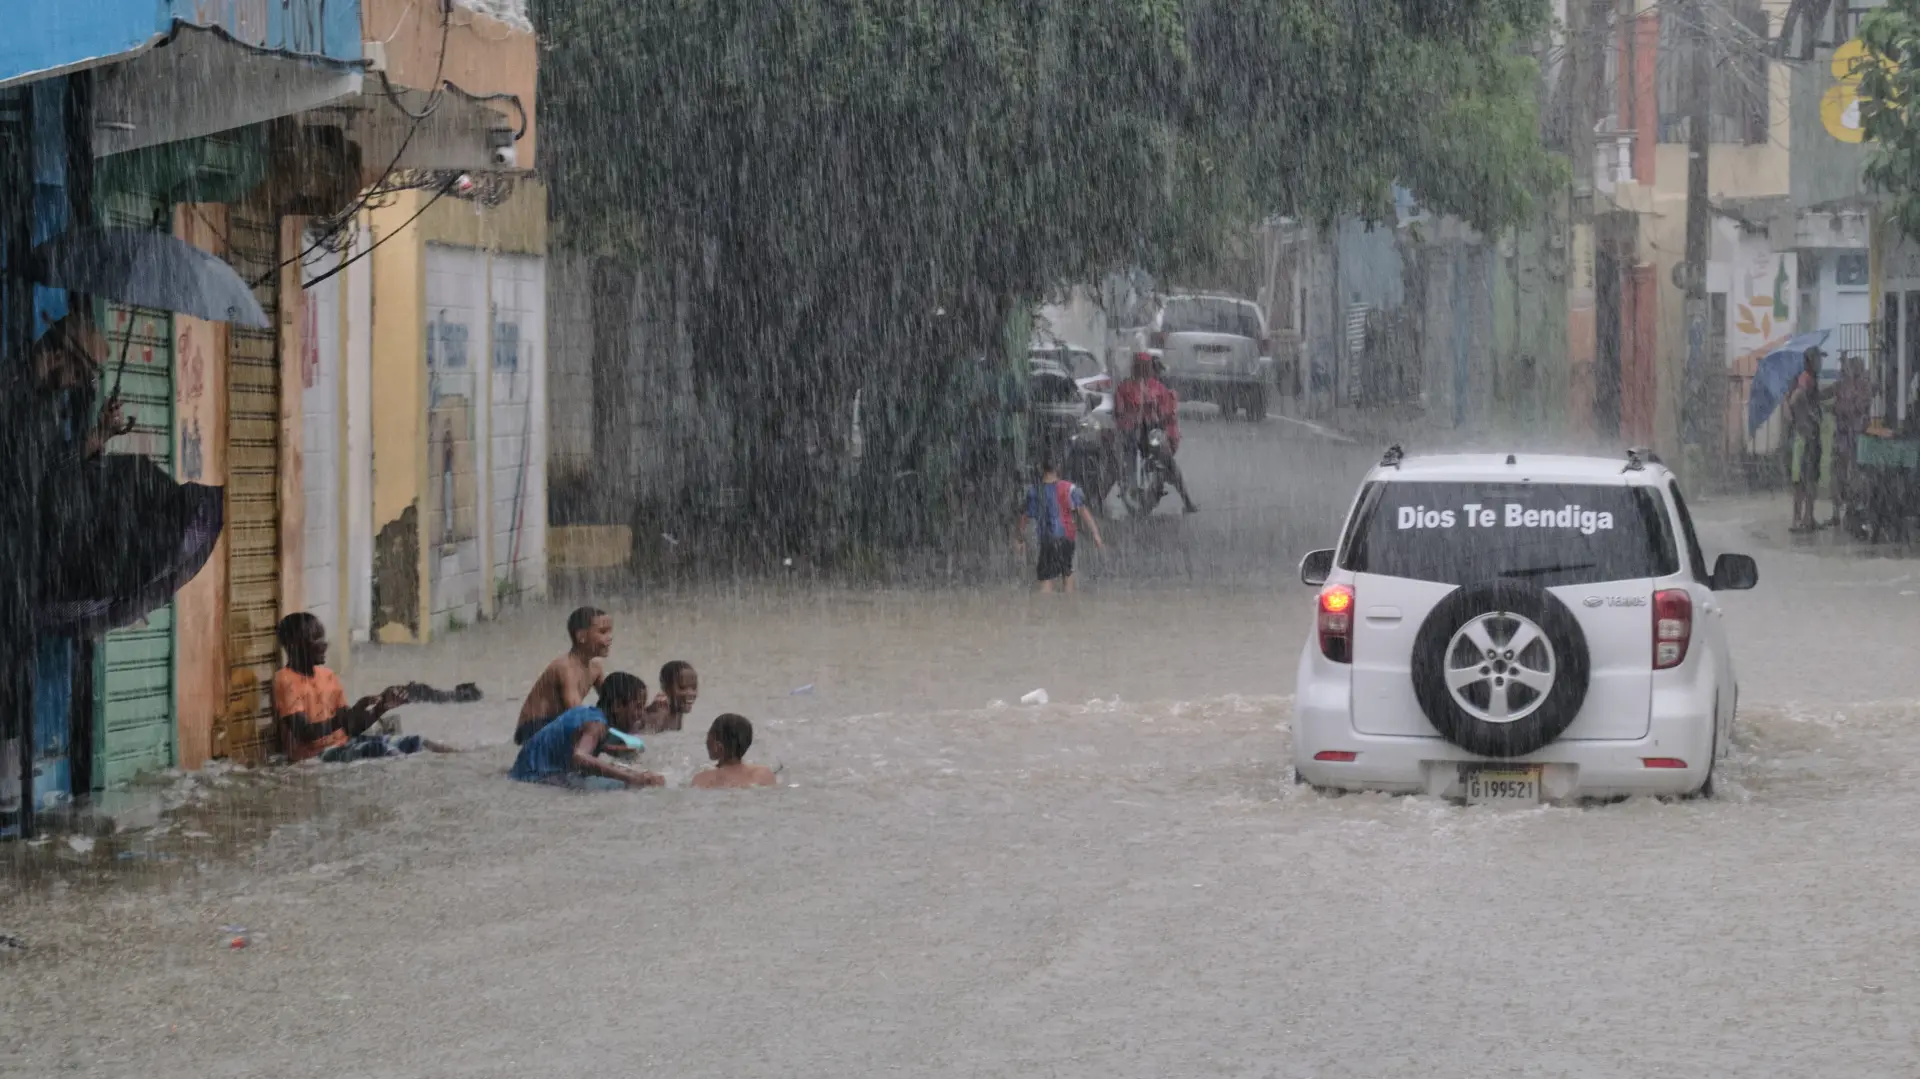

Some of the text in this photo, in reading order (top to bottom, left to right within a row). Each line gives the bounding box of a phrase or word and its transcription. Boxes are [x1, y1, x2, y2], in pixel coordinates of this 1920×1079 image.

[1397, 503, 1614, 535] Dios Te Bendiga
[1471, 780, 1534, 798] G199521
